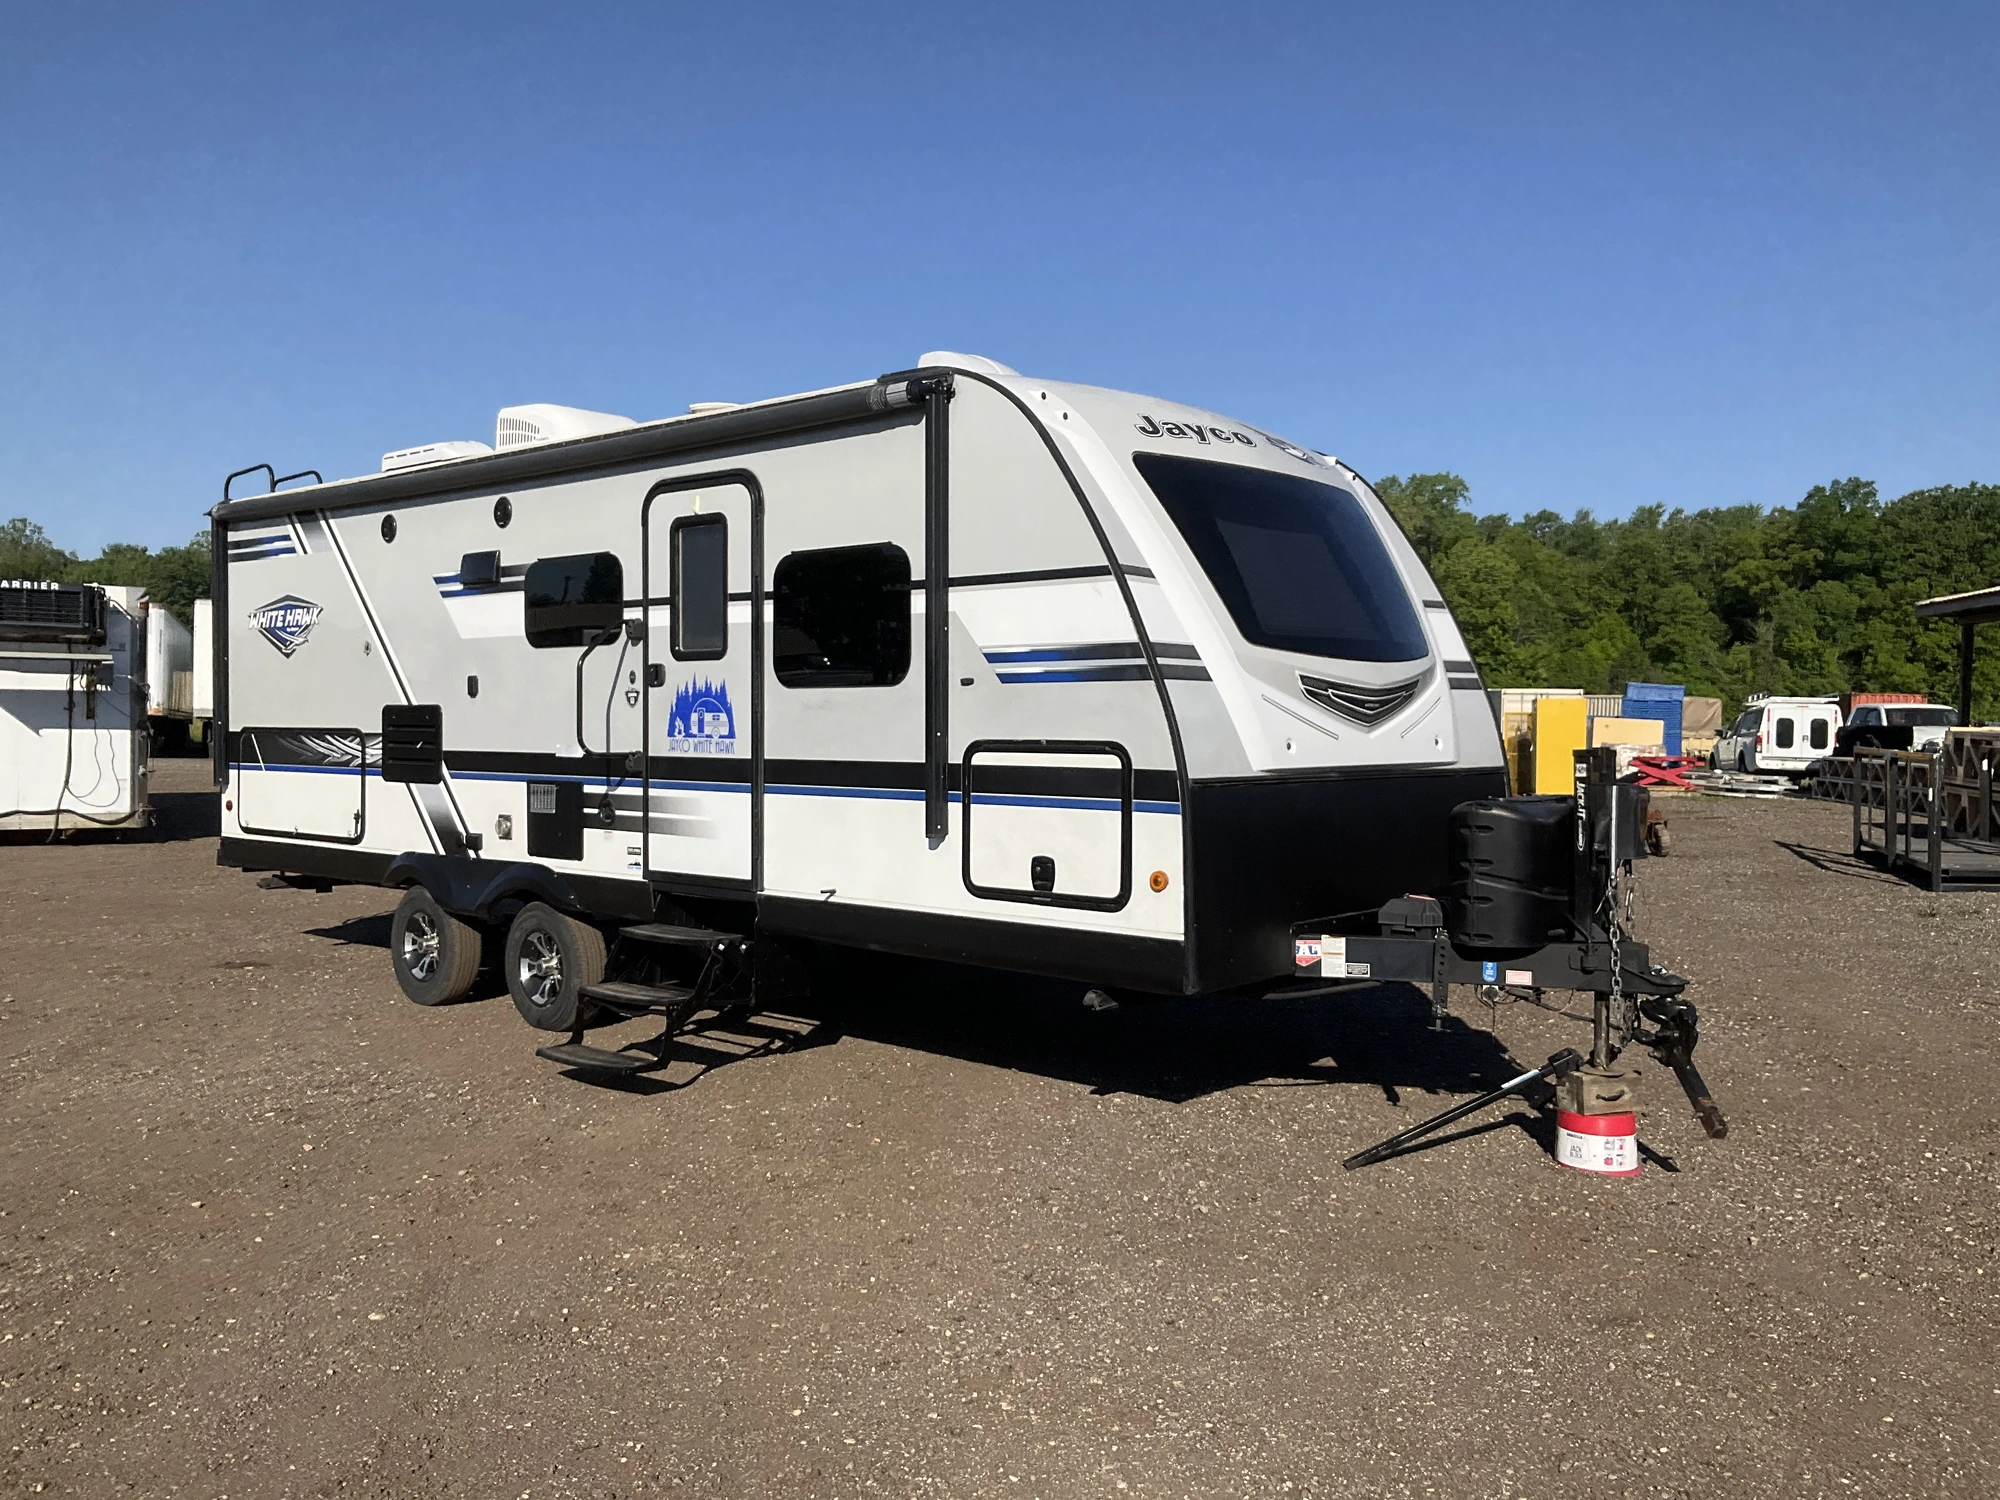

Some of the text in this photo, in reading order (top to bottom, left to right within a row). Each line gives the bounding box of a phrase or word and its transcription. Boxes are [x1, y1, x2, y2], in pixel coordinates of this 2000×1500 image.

[1134, 413, 1257, 447] Jayco
[248, 607, 323, 629] WHITE HAWK
[668, 739, 736, 755] JAYCO WHITE HAWK
